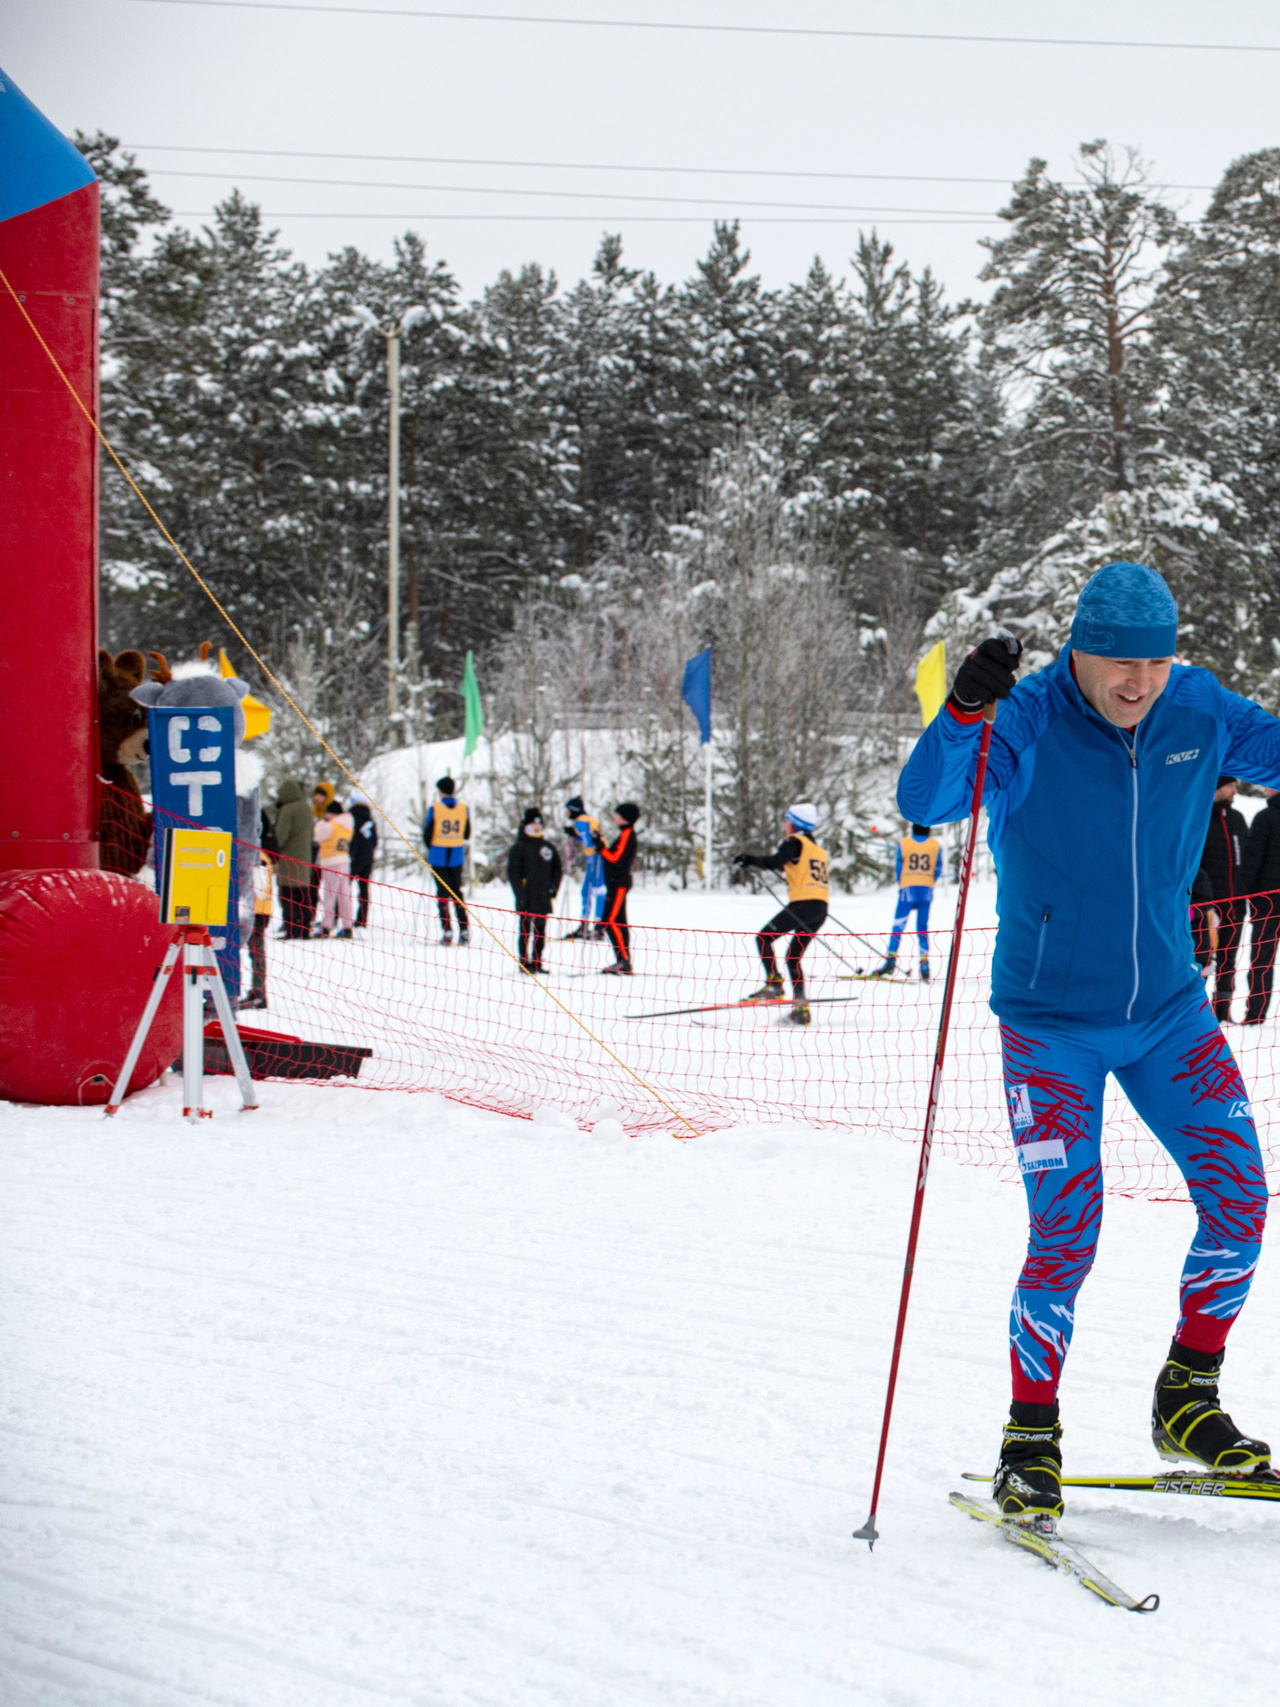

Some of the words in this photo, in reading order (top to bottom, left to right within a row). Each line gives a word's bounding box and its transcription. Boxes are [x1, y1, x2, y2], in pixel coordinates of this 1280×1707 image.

[442, 820, 459, 834] 94
[909, 853, 930, 871] 93
[1027, 1157, 1064, 1172] GAZPROM
[1152, 1480, 1226, 1496] FISCHER
